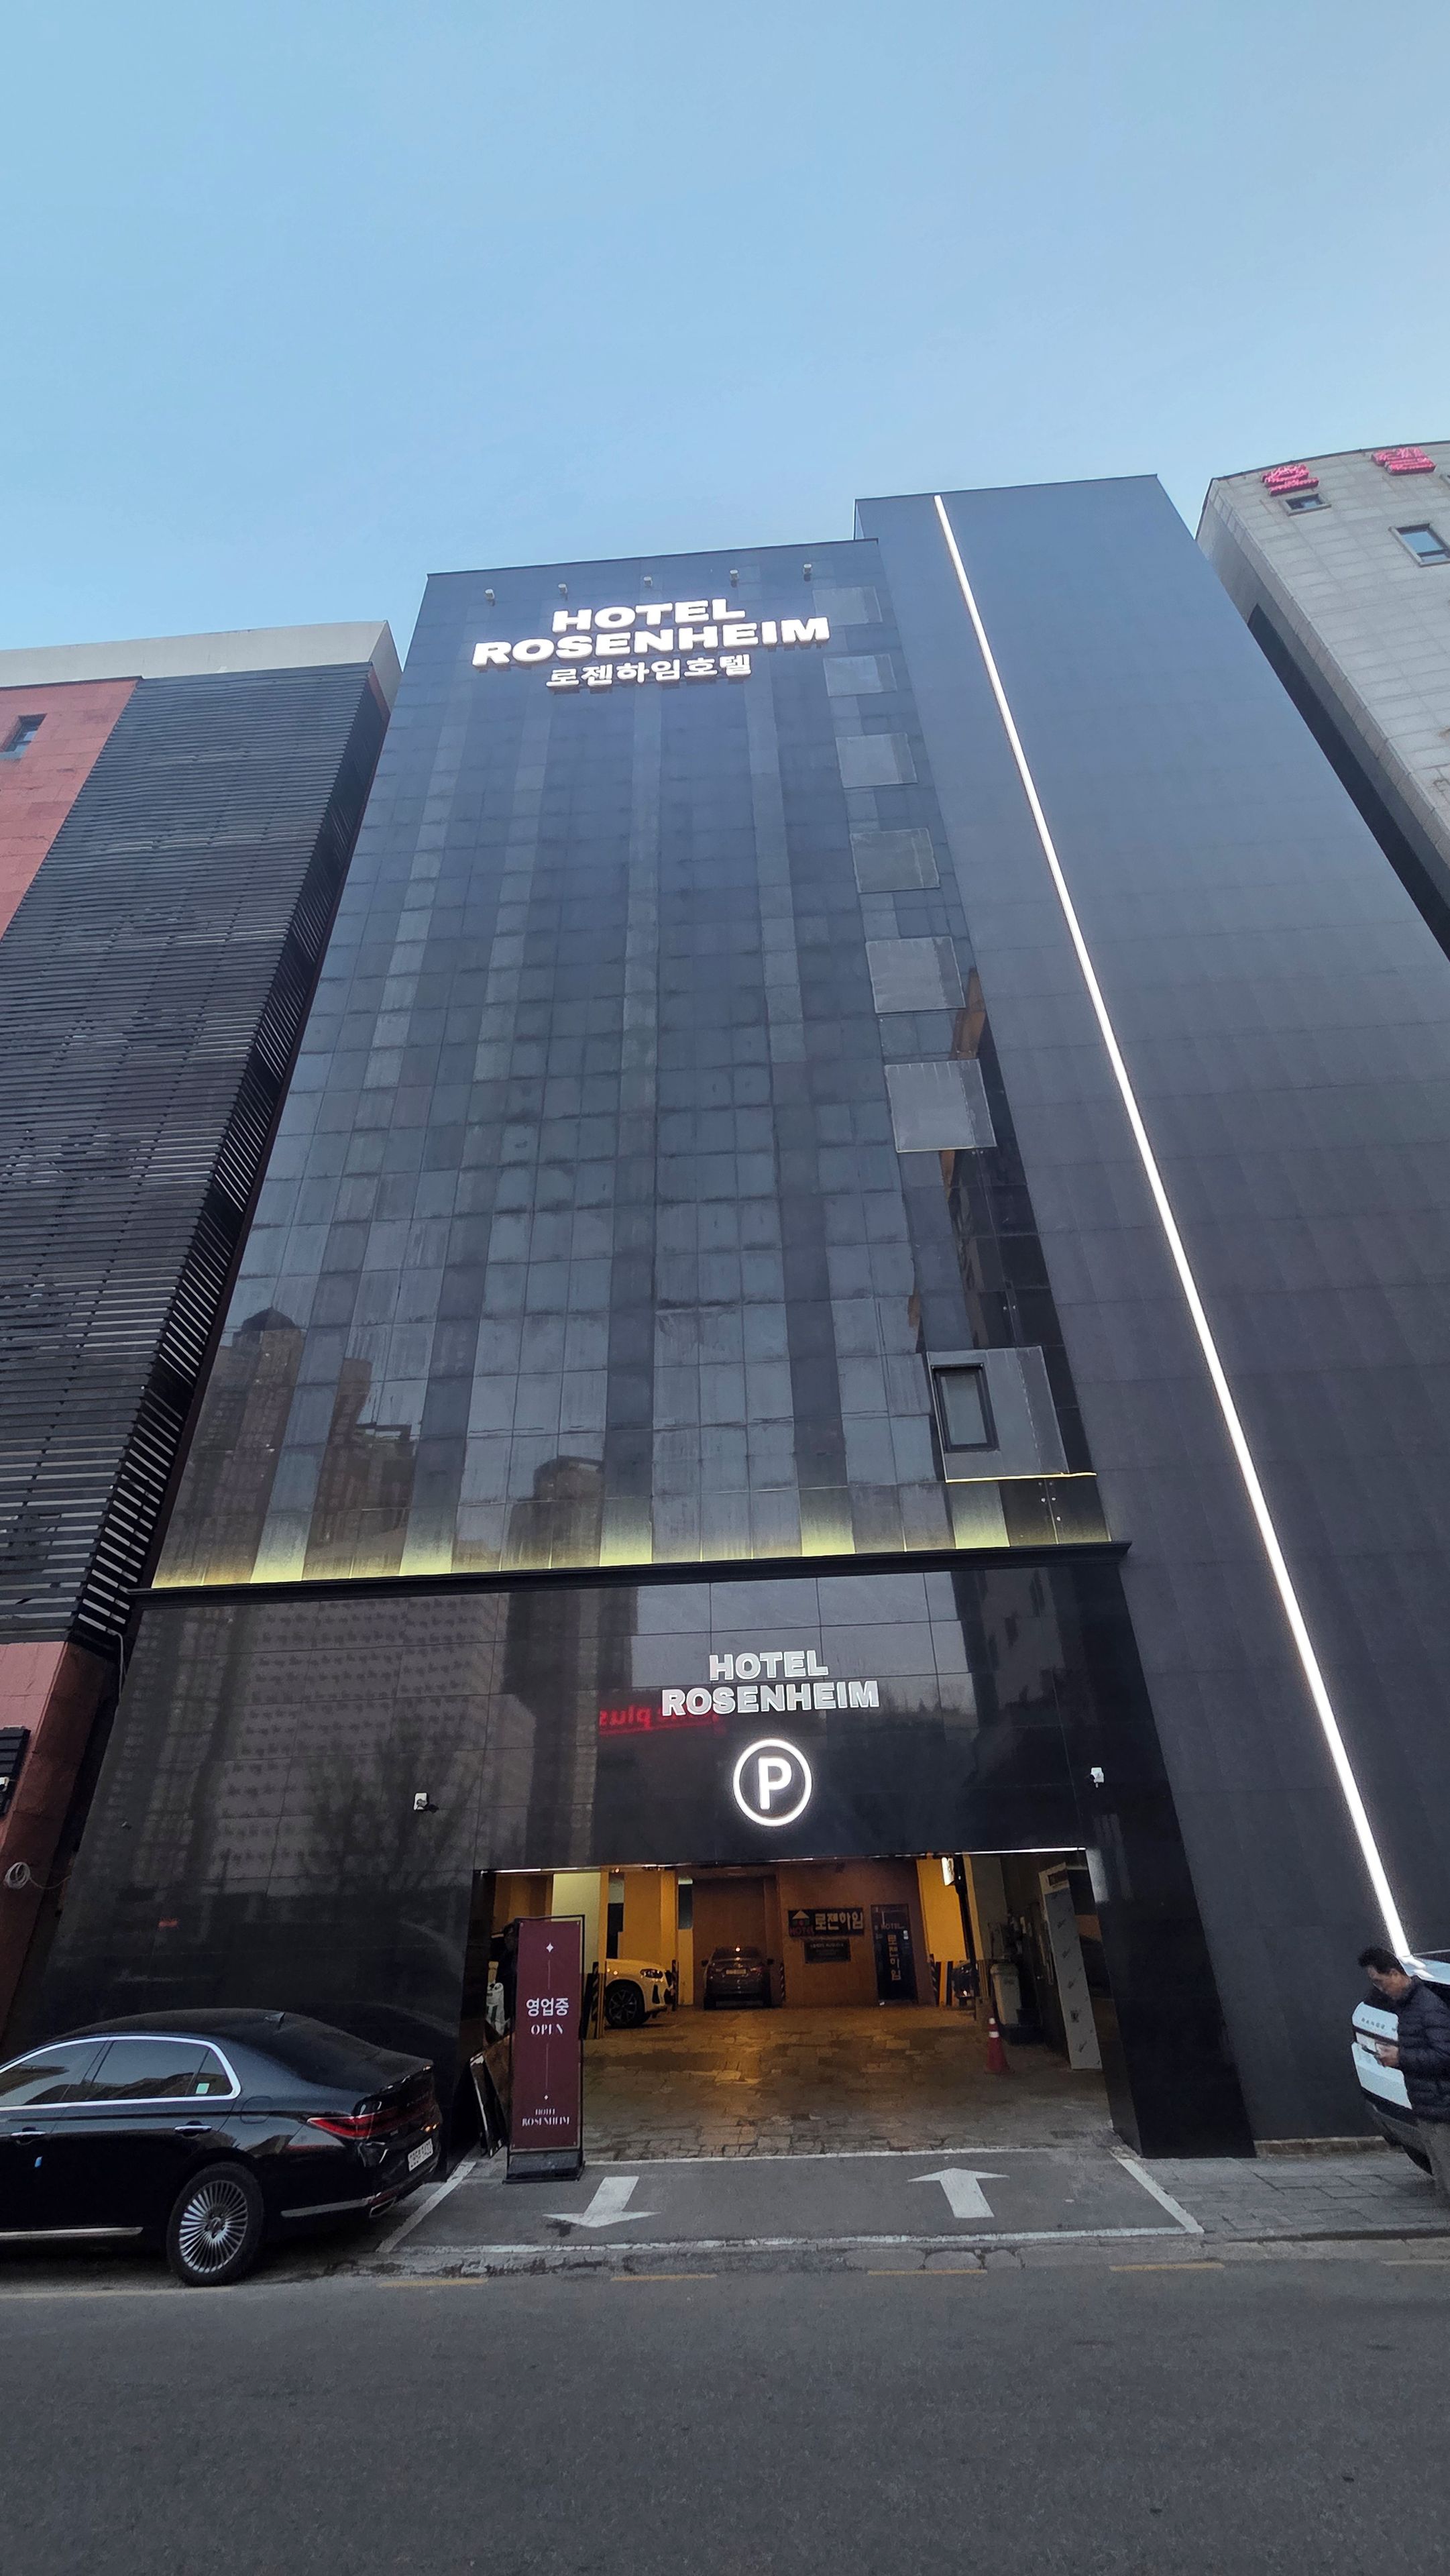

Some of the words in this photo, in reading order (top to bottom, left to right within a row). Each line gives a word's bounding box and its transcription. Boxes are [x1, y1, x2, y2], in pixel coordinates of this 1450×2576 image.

[552, 598, 746, 633] HOTEL
[471, 616, 830, 667] ROSENHEIM
[545, 654, 752, 688] 로젠하임호텔
[709, 1650, 829, 1681] HOTEL
[662, 1680, 879, 1716] ROSENHEIM
[759, 1757, 792, 1809] P
[526, 1997, 569, 2017] 영업중
[531, 2023, 563, 2035] OPEN
[522, 2116, 570, 2127] ROSENHEIM
